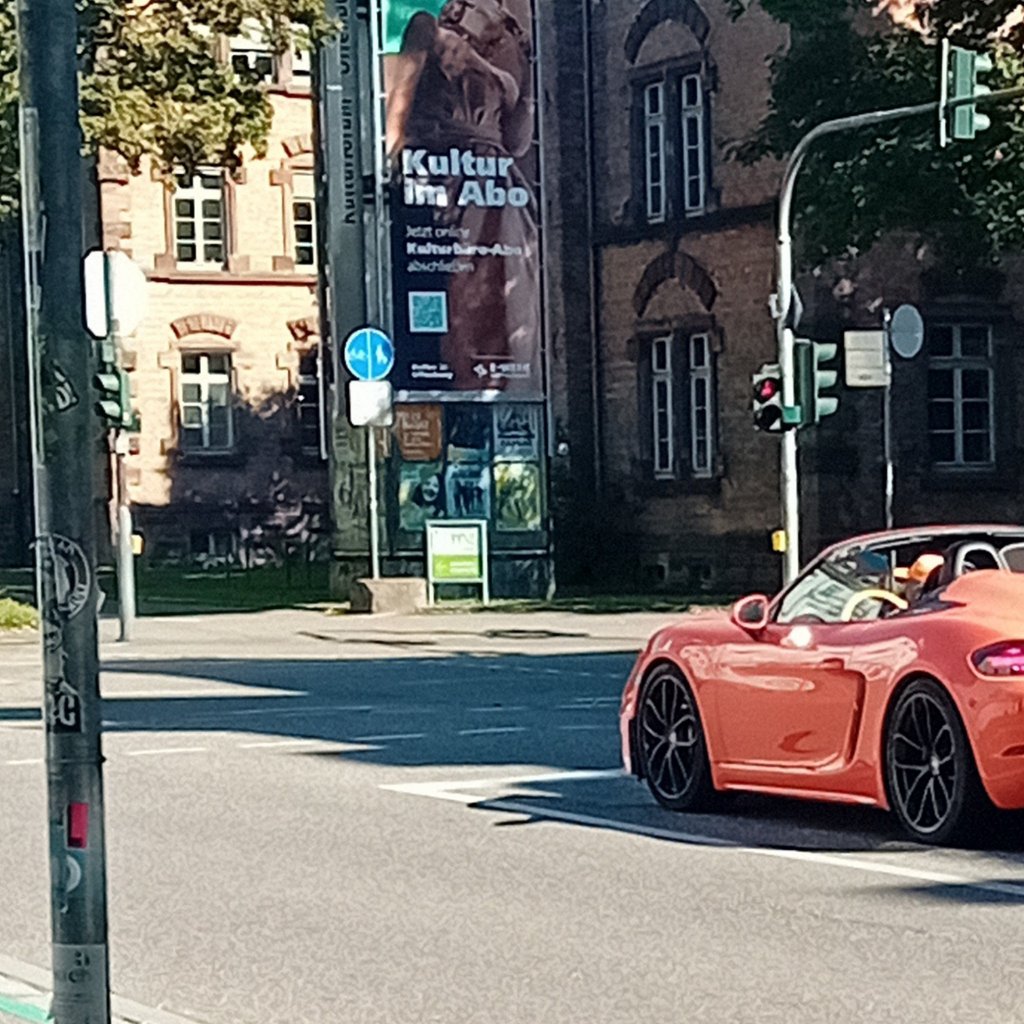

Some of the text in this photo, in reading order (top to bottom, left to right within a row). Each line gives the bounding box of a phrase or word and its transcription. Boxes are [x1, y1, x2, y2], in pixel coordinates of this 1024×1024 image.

[402, 148, 514, 177] Kultur
[404, 177, 528, 207] im Abo
